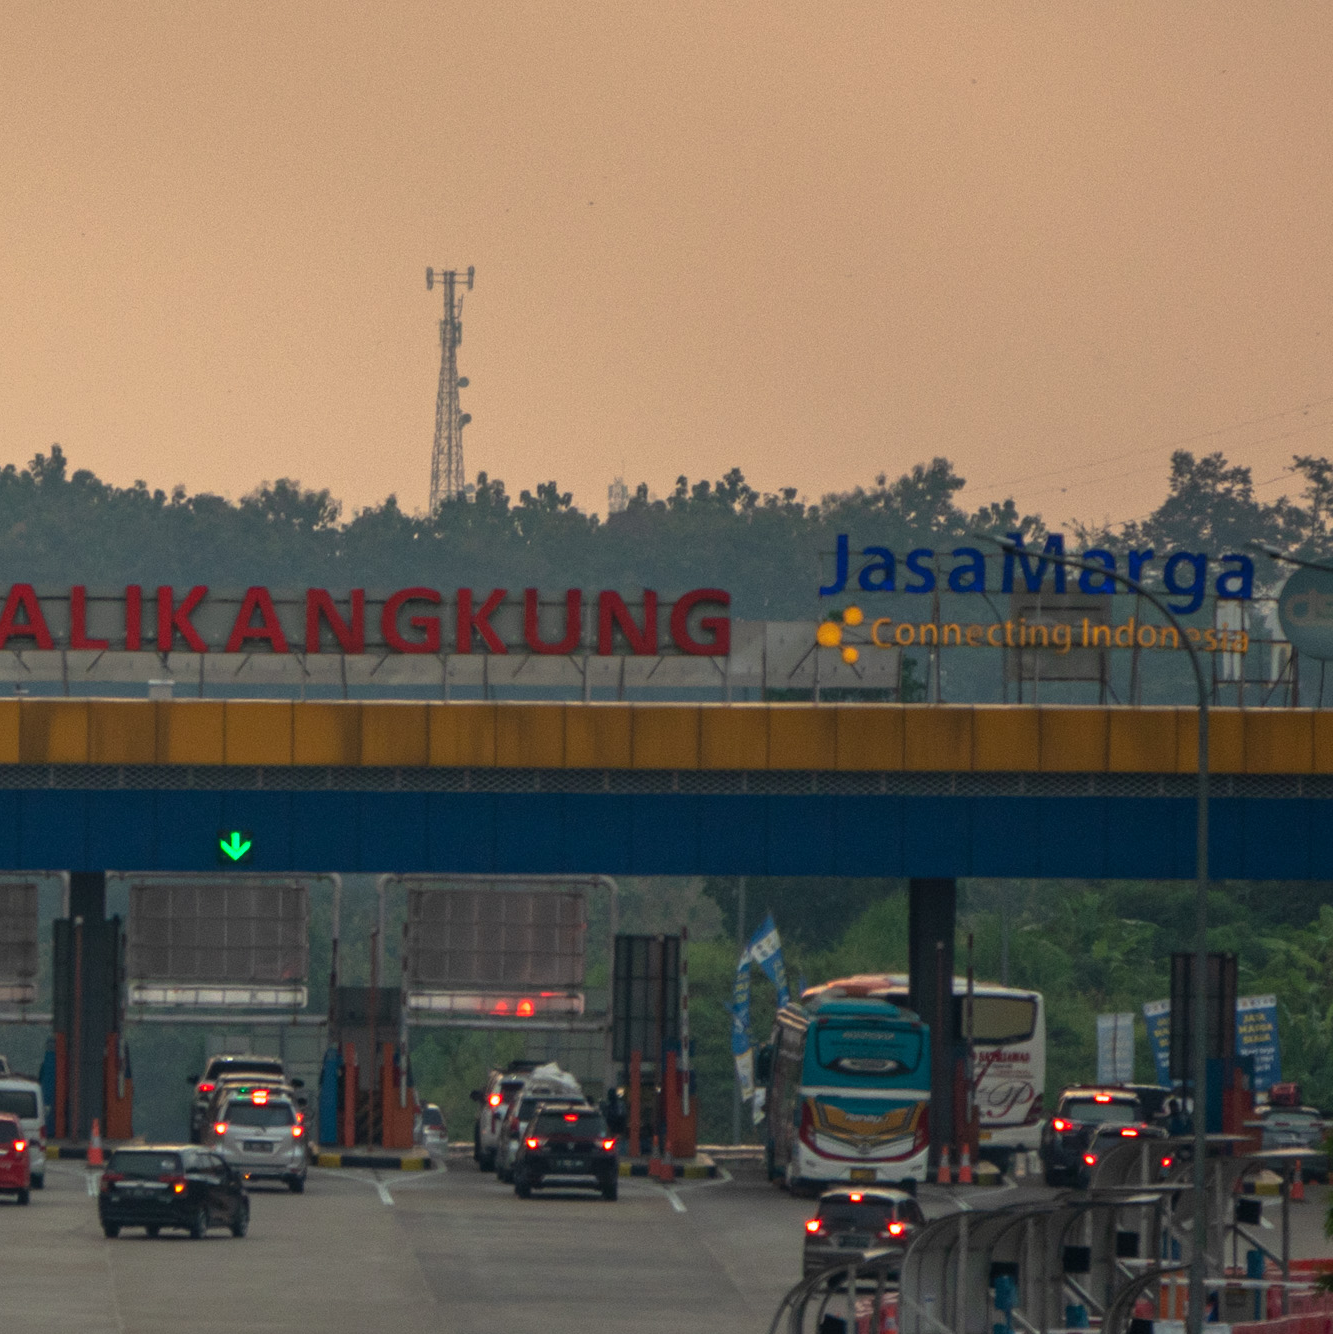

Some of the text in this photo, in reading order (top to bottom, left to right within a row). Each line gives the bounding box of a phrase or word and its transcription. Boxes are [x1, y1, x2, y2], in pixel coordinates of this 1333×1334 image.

[819, 533, 1255, 615] JasaMarga
[872, 617, 1250, 655] Connecting Indonesia
